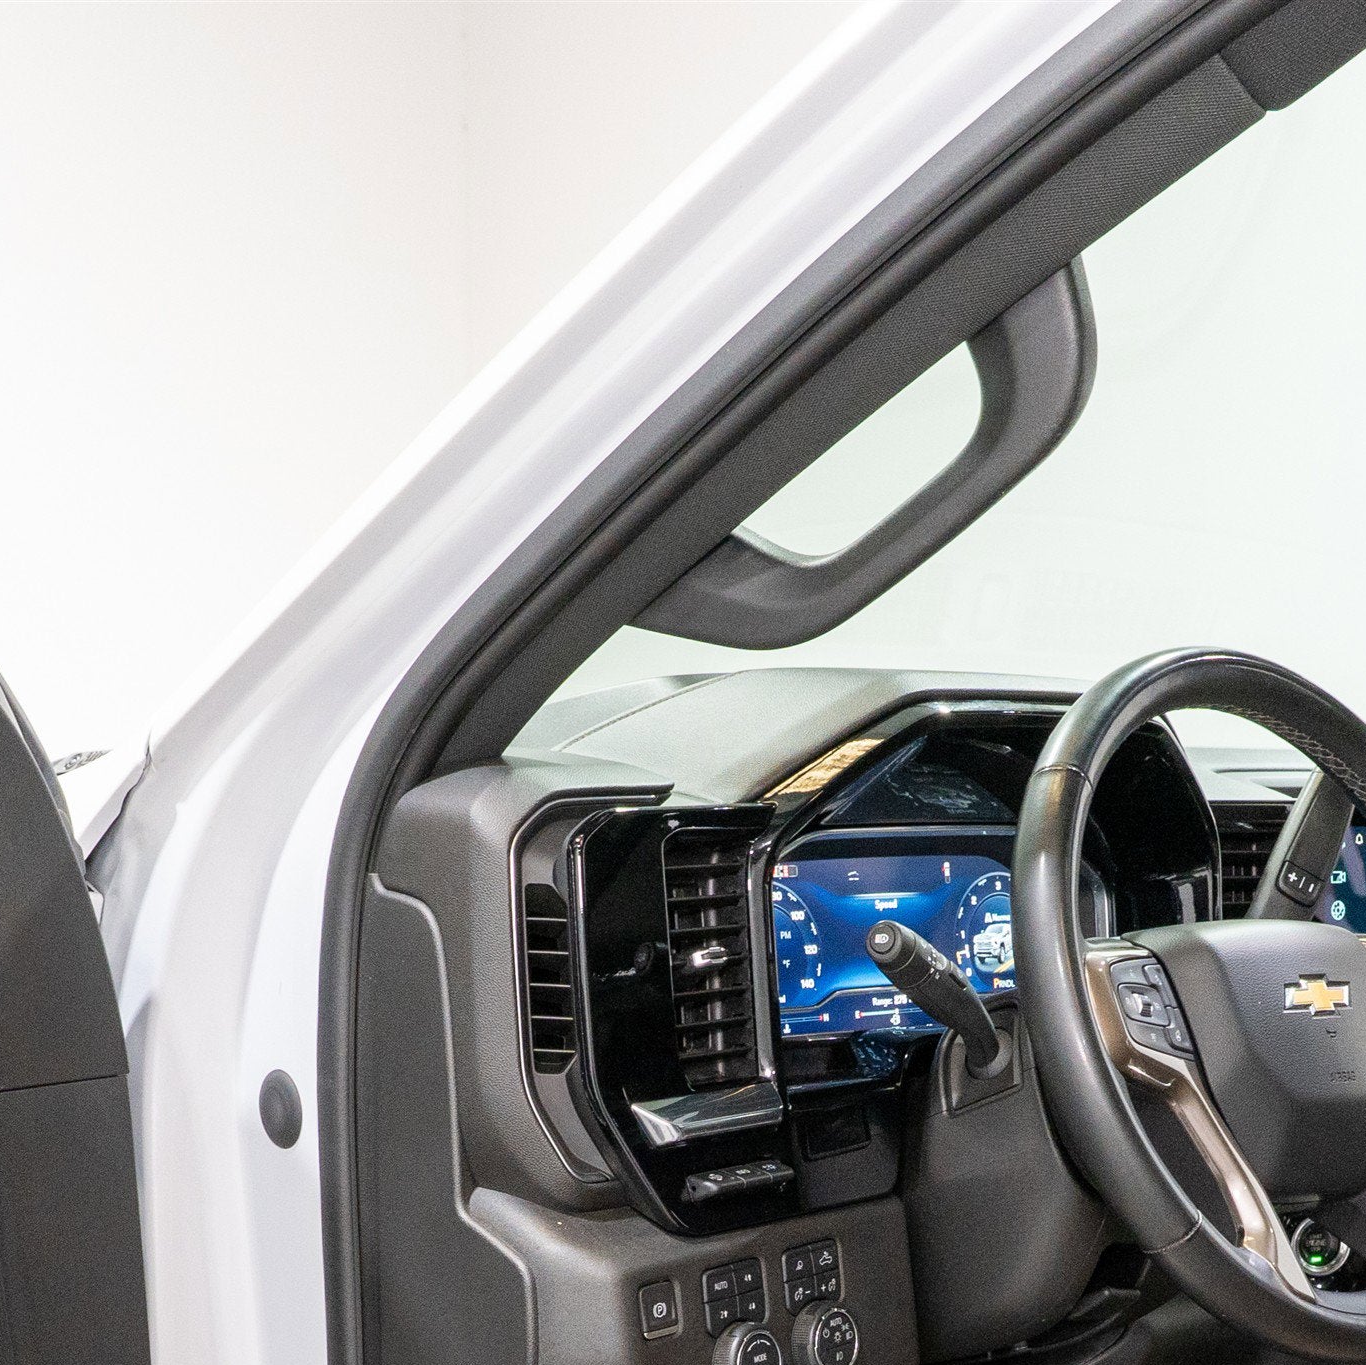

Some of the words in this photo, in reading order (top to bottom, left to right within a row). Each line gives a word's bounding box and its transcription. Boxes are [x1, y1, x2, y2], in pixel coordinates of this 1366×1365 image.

[875, 899, 898, 912] Speed
[790, 910, 805, 921] 100
[780, 930, 792, 940] PM
[803, 944, 818, 955] 120
[800, 978, 815, 989] 140
[714, 1280, 728, 1291] AUTO
[830, 1317, 843, 1327] AUTO
[753, 1352, 767, 1363] MODE
